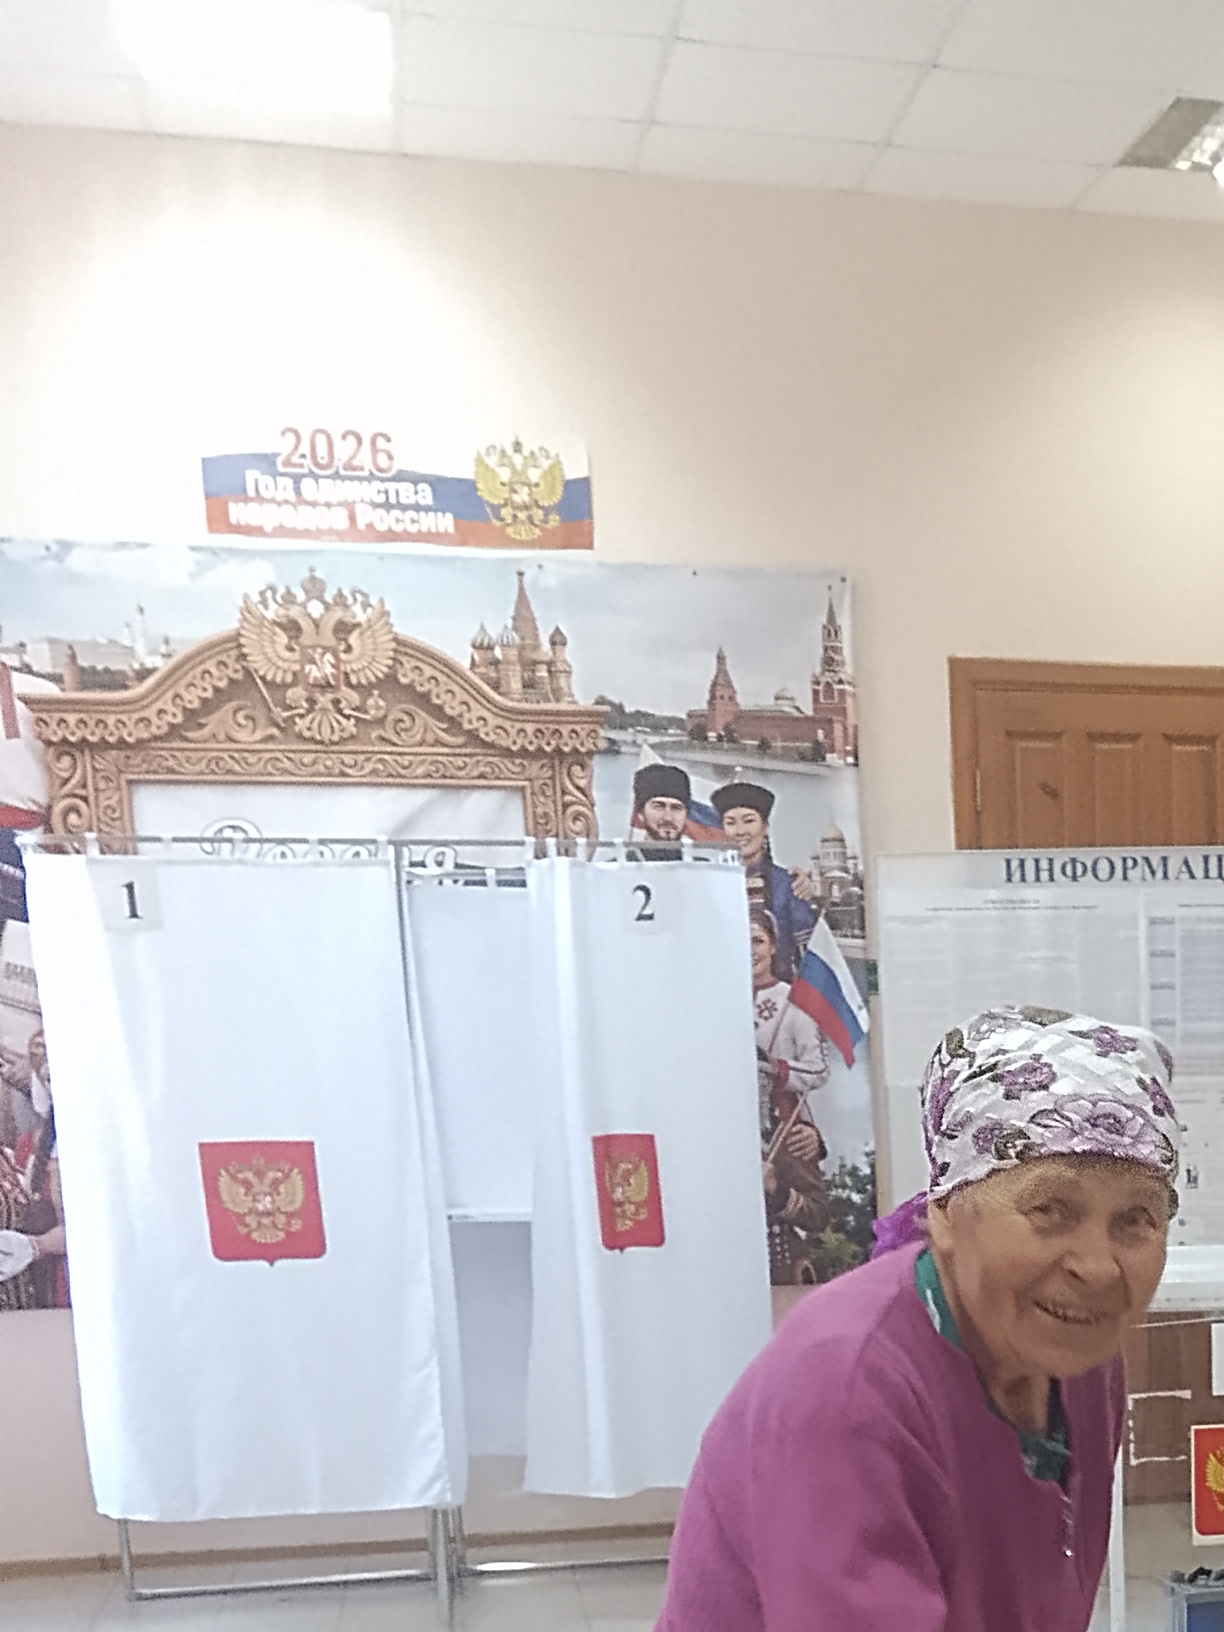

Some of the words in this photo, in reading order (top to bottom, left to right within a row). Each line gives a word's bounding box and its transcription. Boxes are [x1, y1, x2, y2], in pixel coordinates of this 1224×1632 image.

[279, 426, 396, 474] 2026
[245, 469, 296, 501] Год
[355, 504, 455, 534] России
[120, 880, 143, 920] 1
[631, 884, 655, 922] 2
